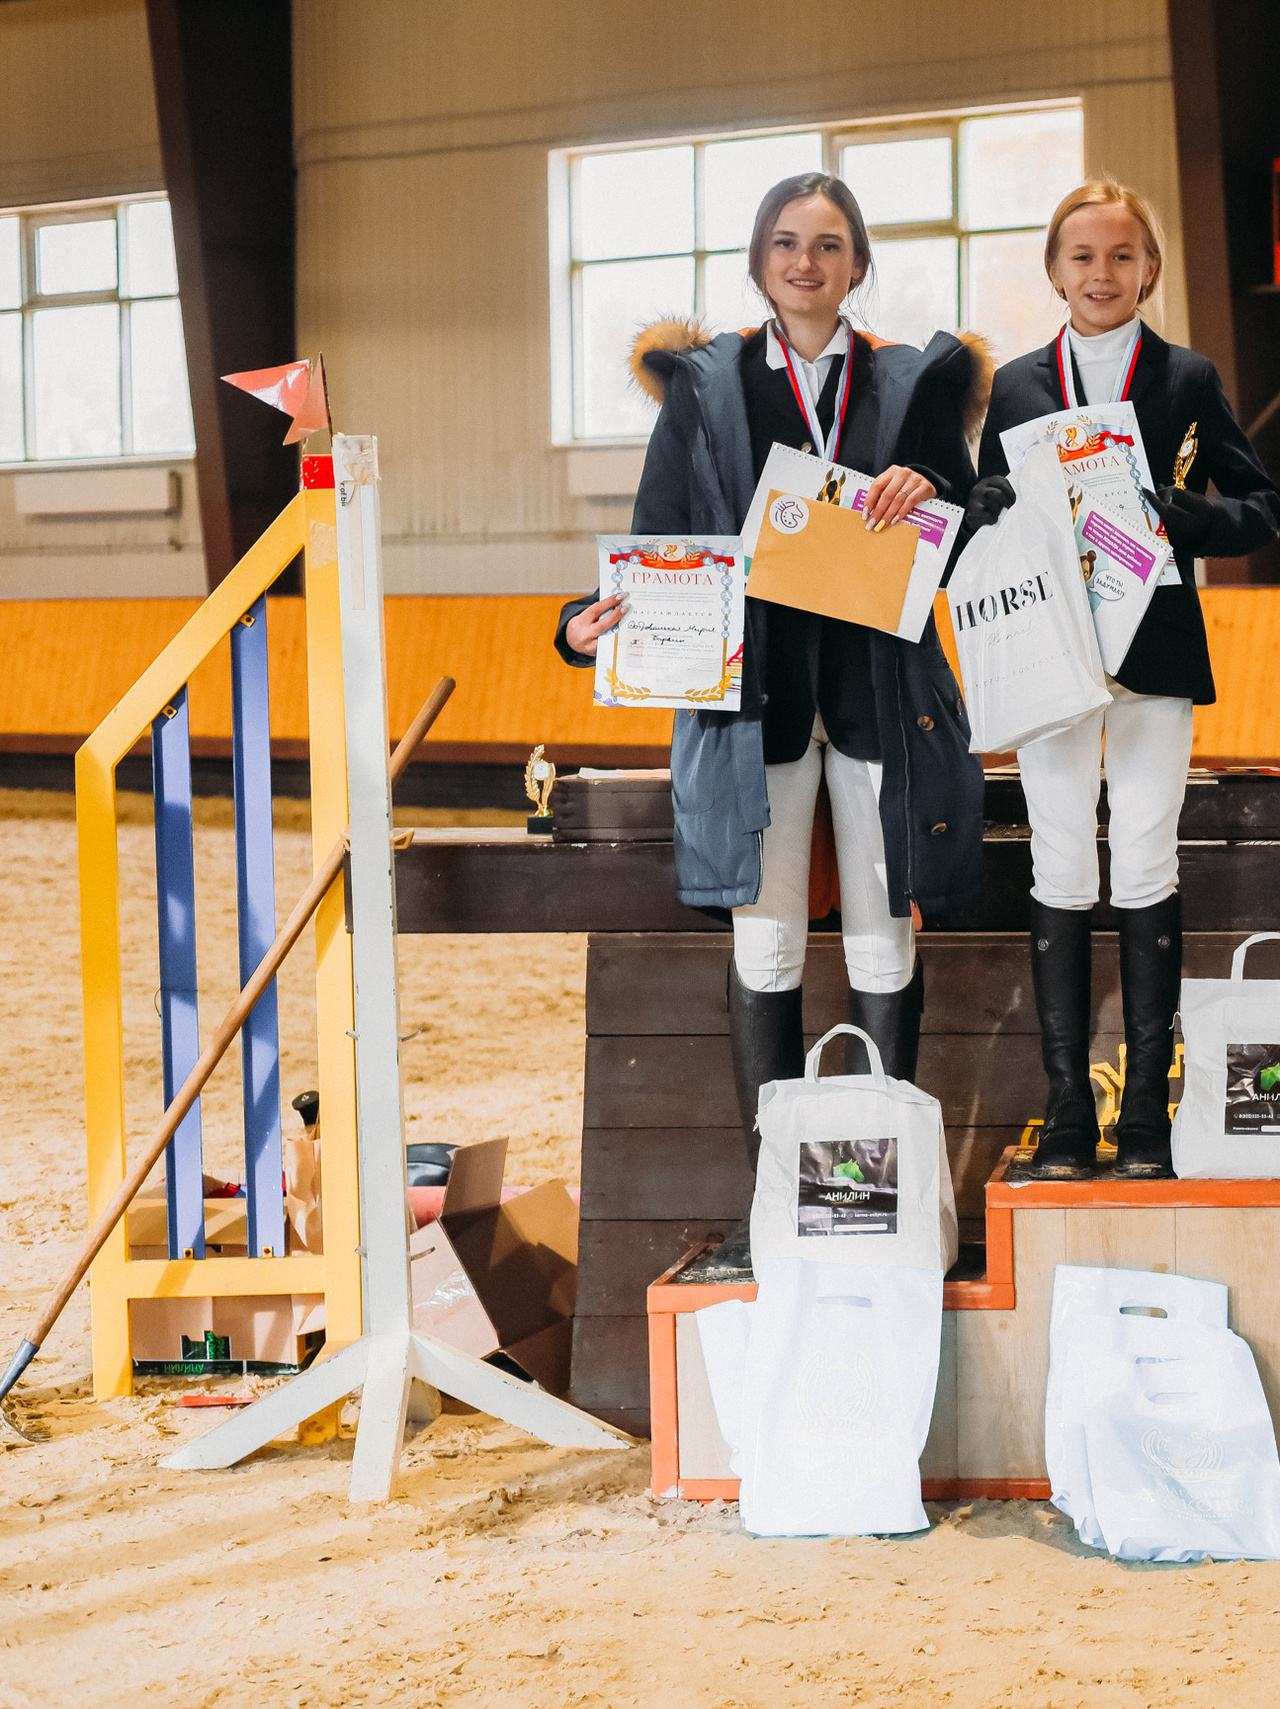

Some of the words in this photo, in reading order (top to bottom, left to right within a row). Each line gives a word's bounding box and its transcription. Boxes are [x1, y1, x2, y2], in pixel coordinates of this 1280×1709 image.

[632, 572, 714, 586] ГРАМОТА
[956, 571, 1053, 632] HORSE
[825, 1191, 870, 1200] АНИЛИН
